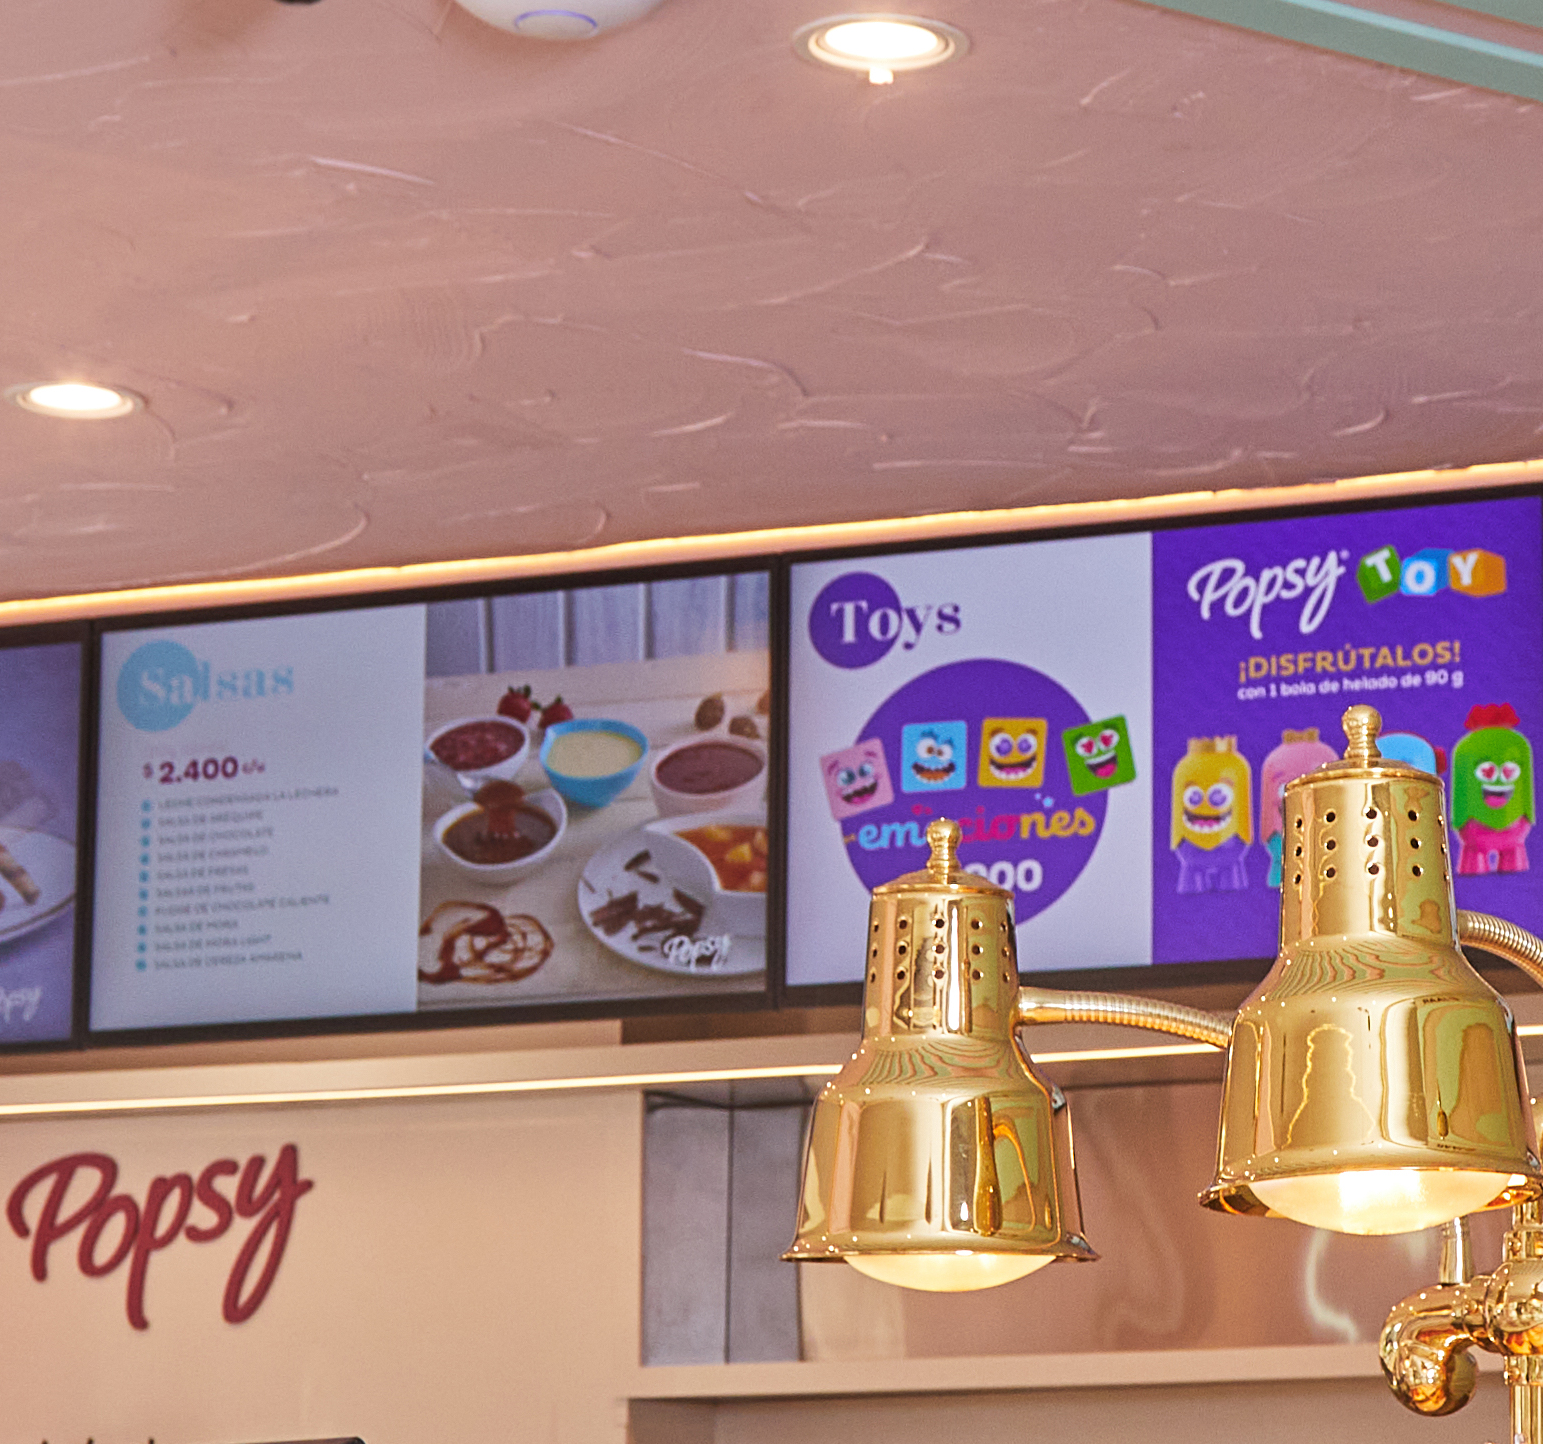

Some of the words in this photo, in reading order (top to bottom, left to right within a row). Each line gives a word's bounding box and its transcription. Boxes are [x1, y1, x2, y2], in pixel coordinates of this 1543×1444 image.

[1188, 550, 1345, 640] Popsy
[1364, 548, 1480, 594] TOY
[830, 599, 961, 650] Toys
[140, 660, 295, 705] Salsas
[1238, 640, 1461, 684] ¡DISFRÚTALOS!
[1238, 684, 1267, 700] con
[1270, 683, 1278, 698] 1
[1280, 679, 1317, 697] bola
[1319, 676, 1340, 695] de
[1342, 674, 1398, 693] helado
[1400, 671, 1422, 689] de
[1425, 668, 1449, 686] 90
[1451, 670, 1465, 689] g
[159, 755, 239, 784] 2.400
[859, 806, 1096, 850] emciones
[6, 1143, 315, 1330] Popsy
